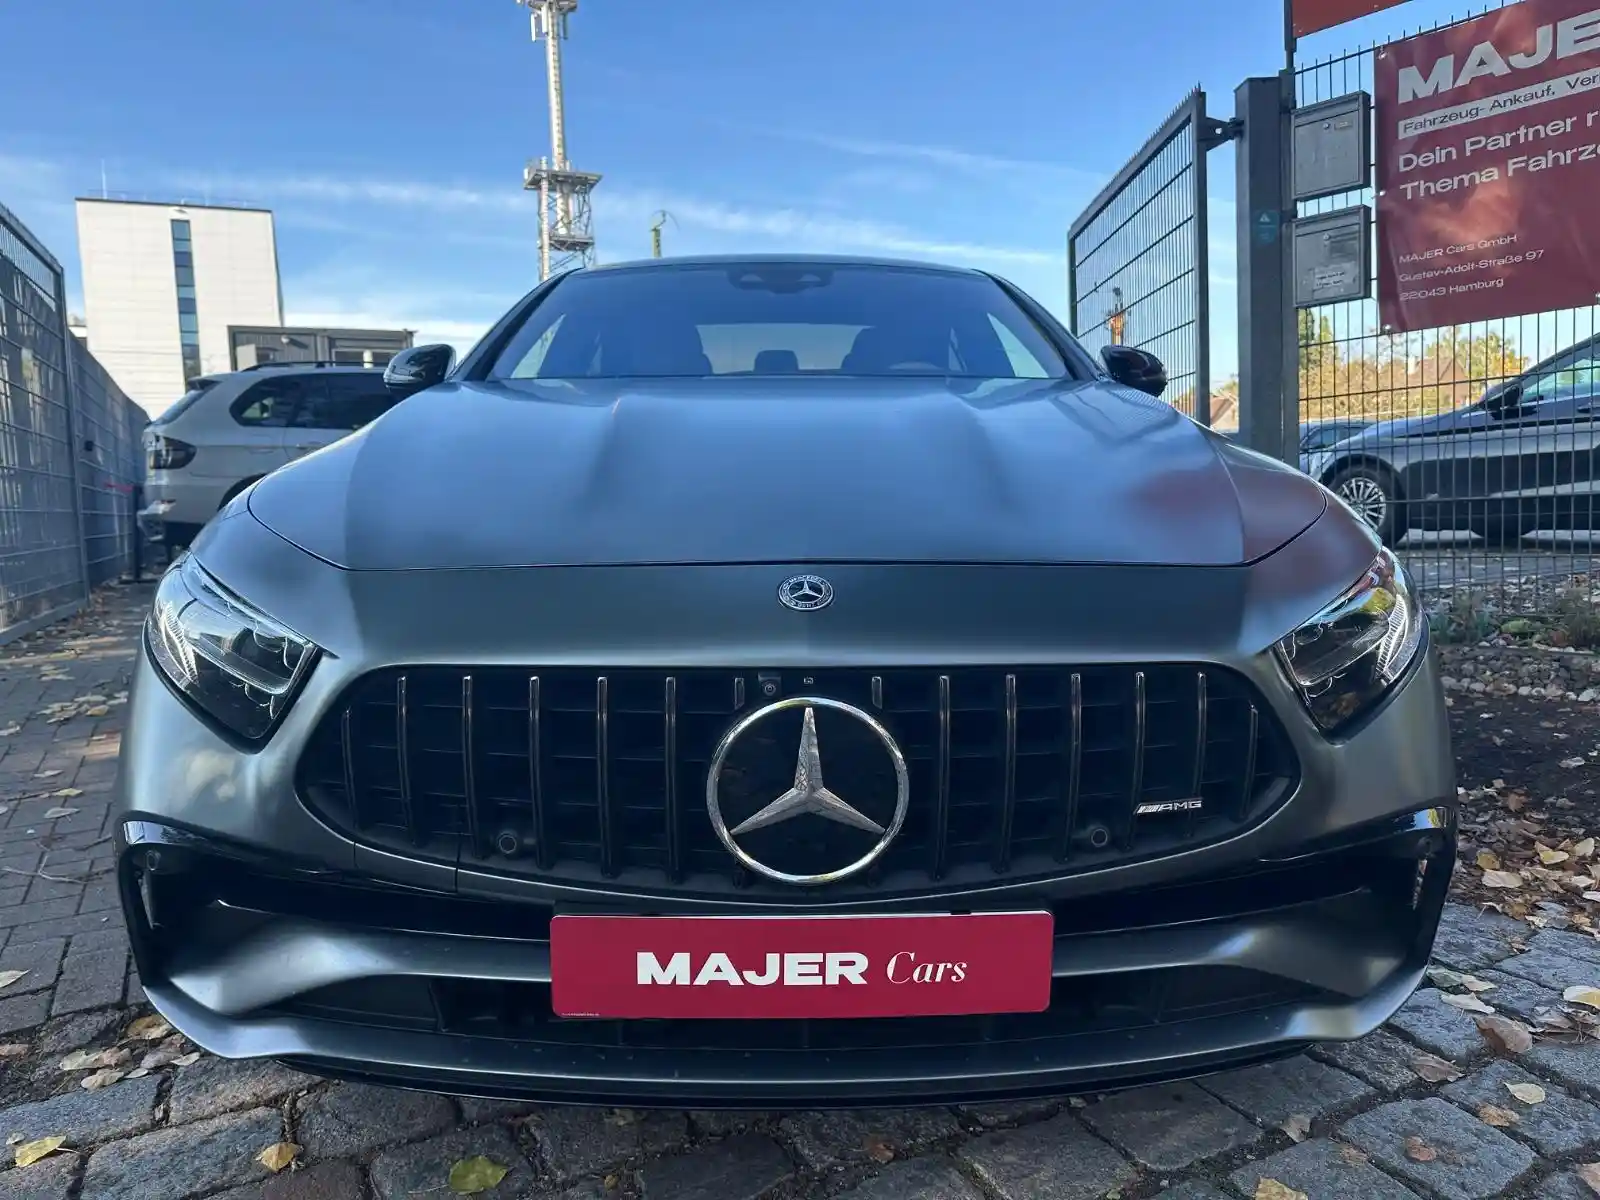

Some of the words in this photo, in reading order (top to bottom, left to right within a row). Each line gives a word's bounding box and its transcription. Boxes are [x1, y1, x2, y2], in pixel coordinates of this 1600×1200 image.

[1403, 106, 1486, 133] Fahrzeug-
[1489, 85, 1555, 111] Ankauf,
[1399, 146, 1457, 172] Dein
[1465, 116, 1577, 156] Partner
[1400, 166, 1499, 200] Thema
[1507, 144, 1600, 177] Fahrz
[1399, 248, 1444, 263] MAJER
[1446, 243, 1475, 255] Cars
[1477, 234, 1517, 249] GmbH
[1525, 249, 1545, 260] 97
[1399, 286, 1446, 301] 22043
[1449, 277, 1504, 294] Hamburg
[1159, 800, 1202, 811] AMG
[637, 951, 868, 986] MAJER
[886, 951, 967, 984] Cars
